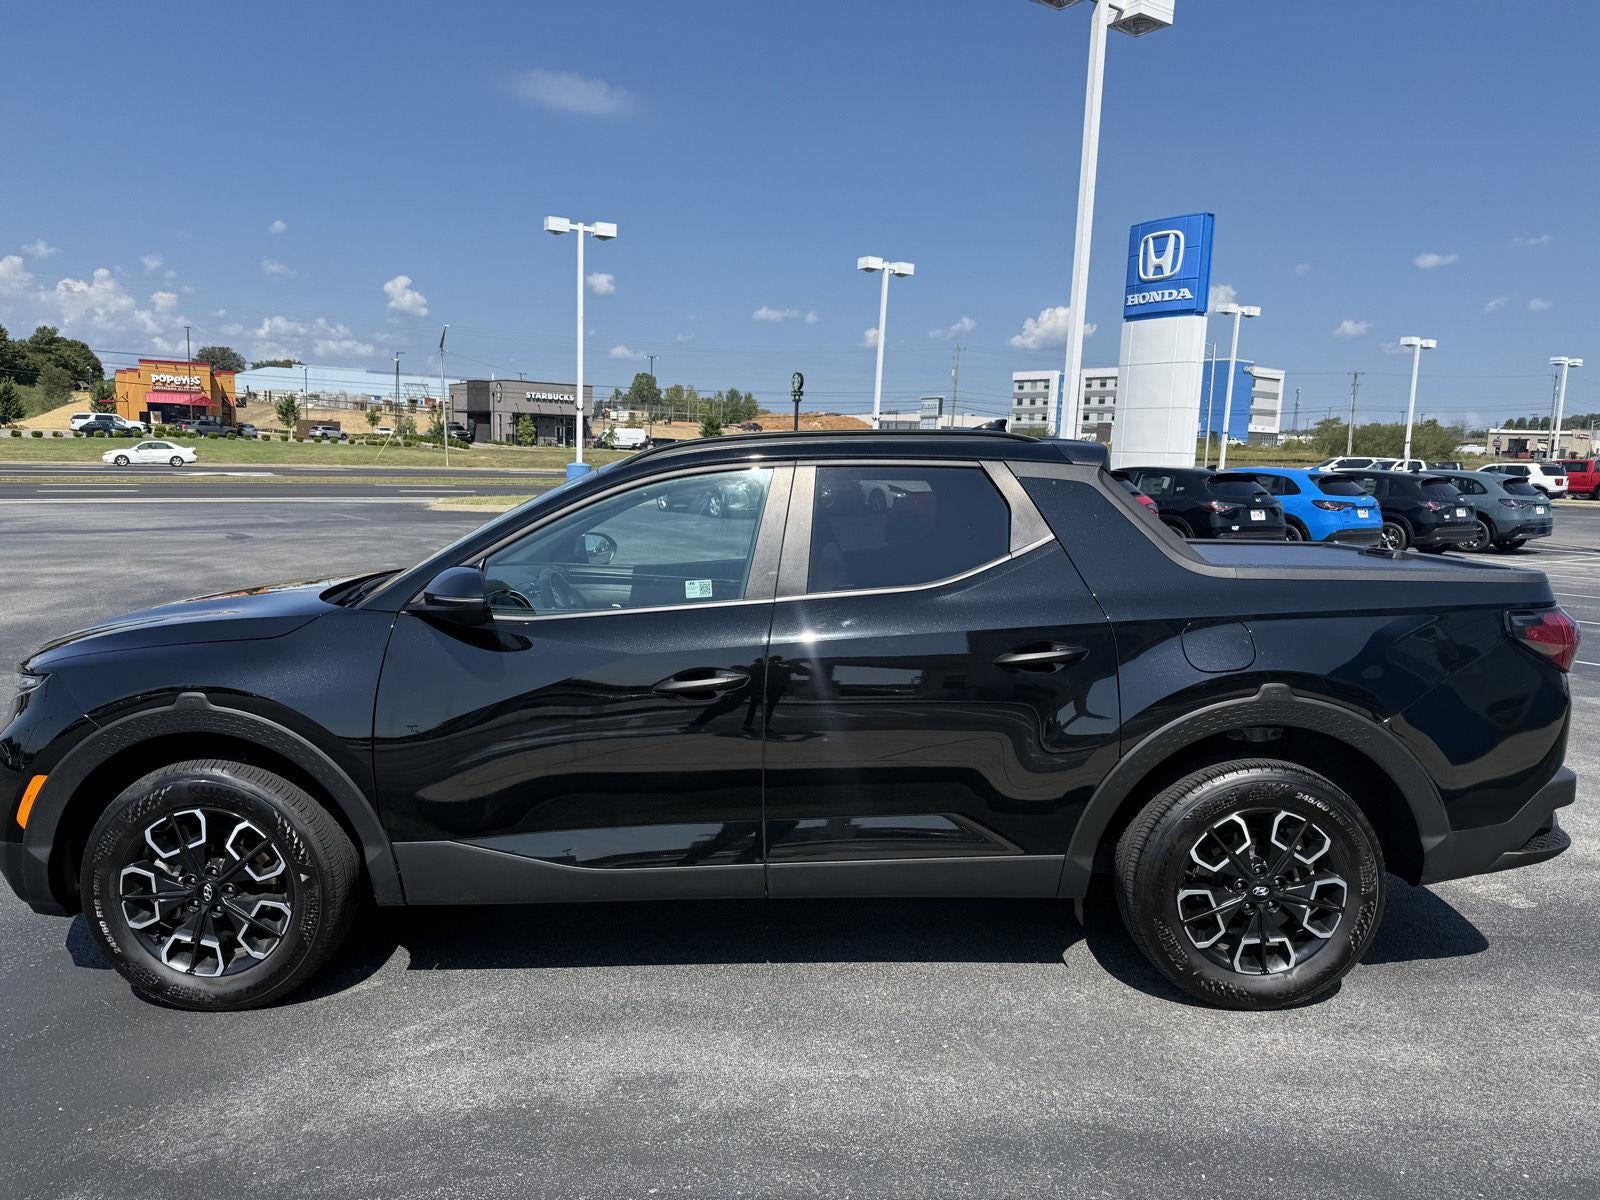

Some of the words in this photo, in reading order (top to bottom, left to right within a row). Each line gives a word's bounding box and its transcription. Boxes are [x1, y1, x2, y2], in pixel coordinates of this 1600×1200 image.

[1126, 288, 1193, 305] HONDA
[525, 391, 575, 401] STARBUCKS
[1295, 791, 1330, 812] 245/60
[99, 920, 121, 954] 245/60
